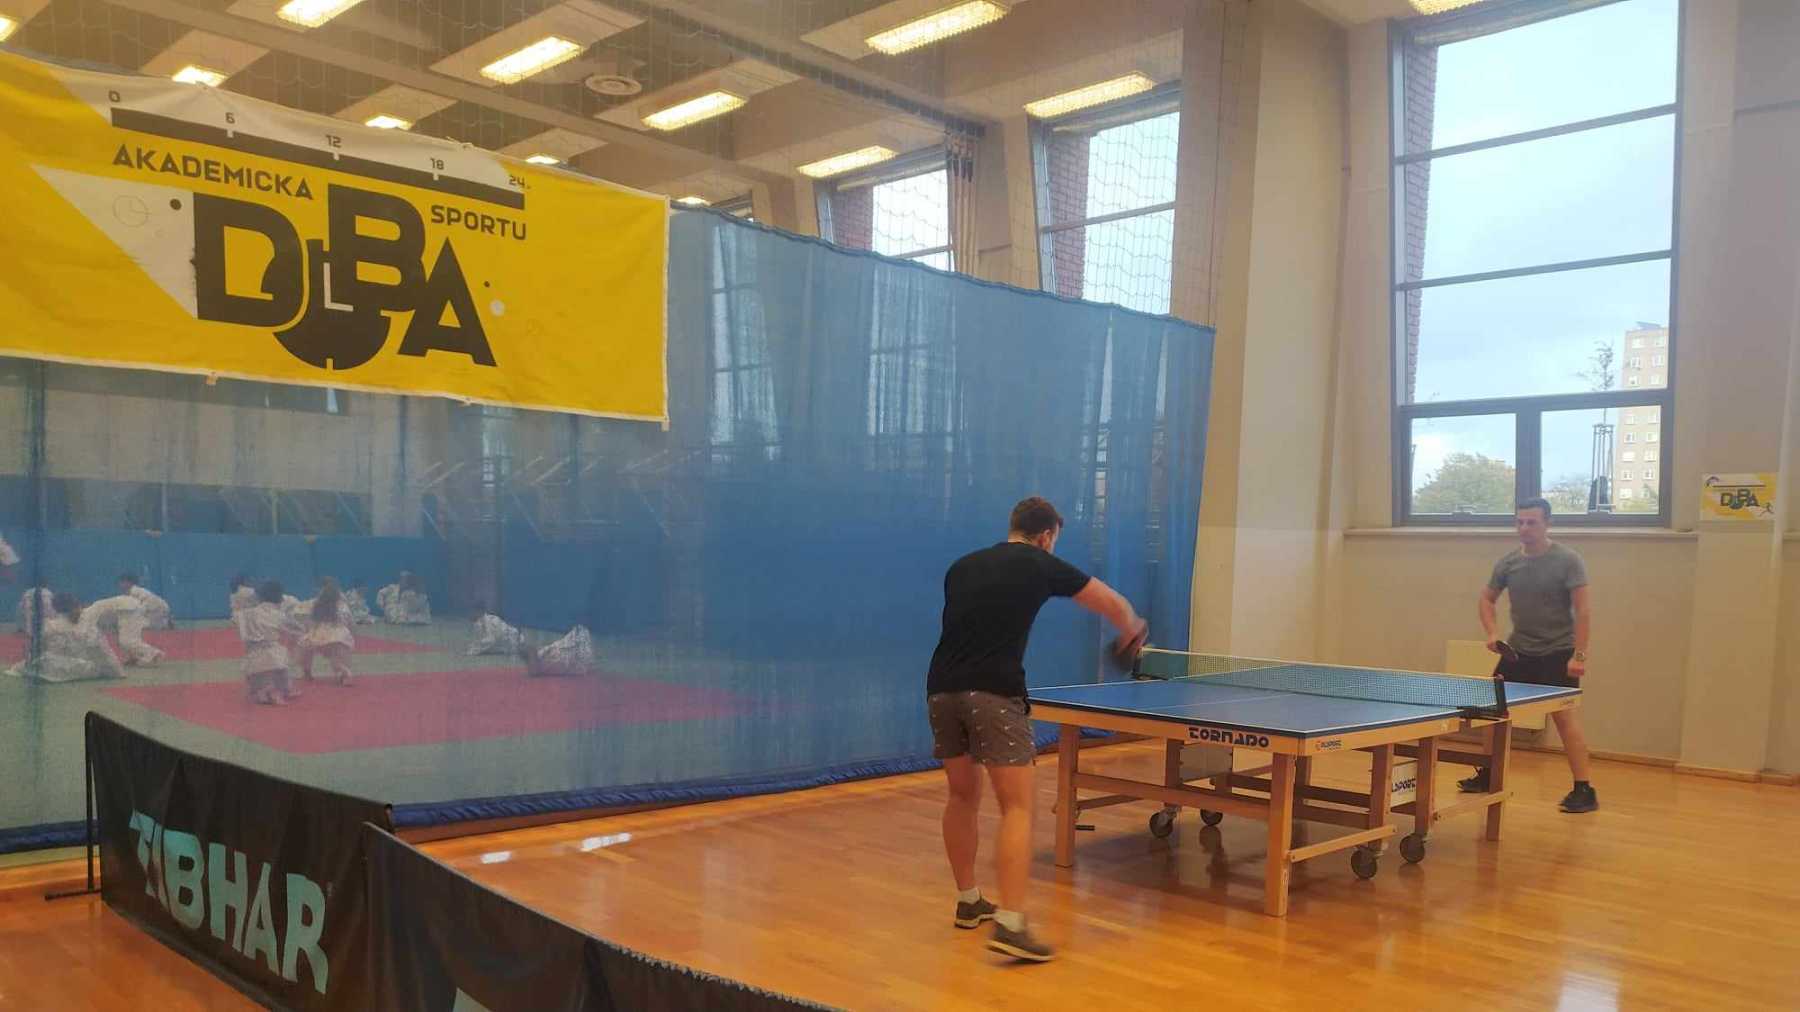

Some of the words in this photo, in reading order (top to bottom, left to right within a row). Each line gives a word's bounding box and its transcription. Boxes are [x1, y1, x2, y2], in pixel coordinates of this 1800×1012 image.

[225, 112, 236, 125] 6
[325, 134, 342, 149] 12
[430, 157, 445, 171] 18
[112, 143, 314, 200] AKADEMICKA
[431, 204, 527, 241] SPORTU
[1188, 727, 1269, 748] TORNADO
[128, 808, 328, 994] TIBHAR
